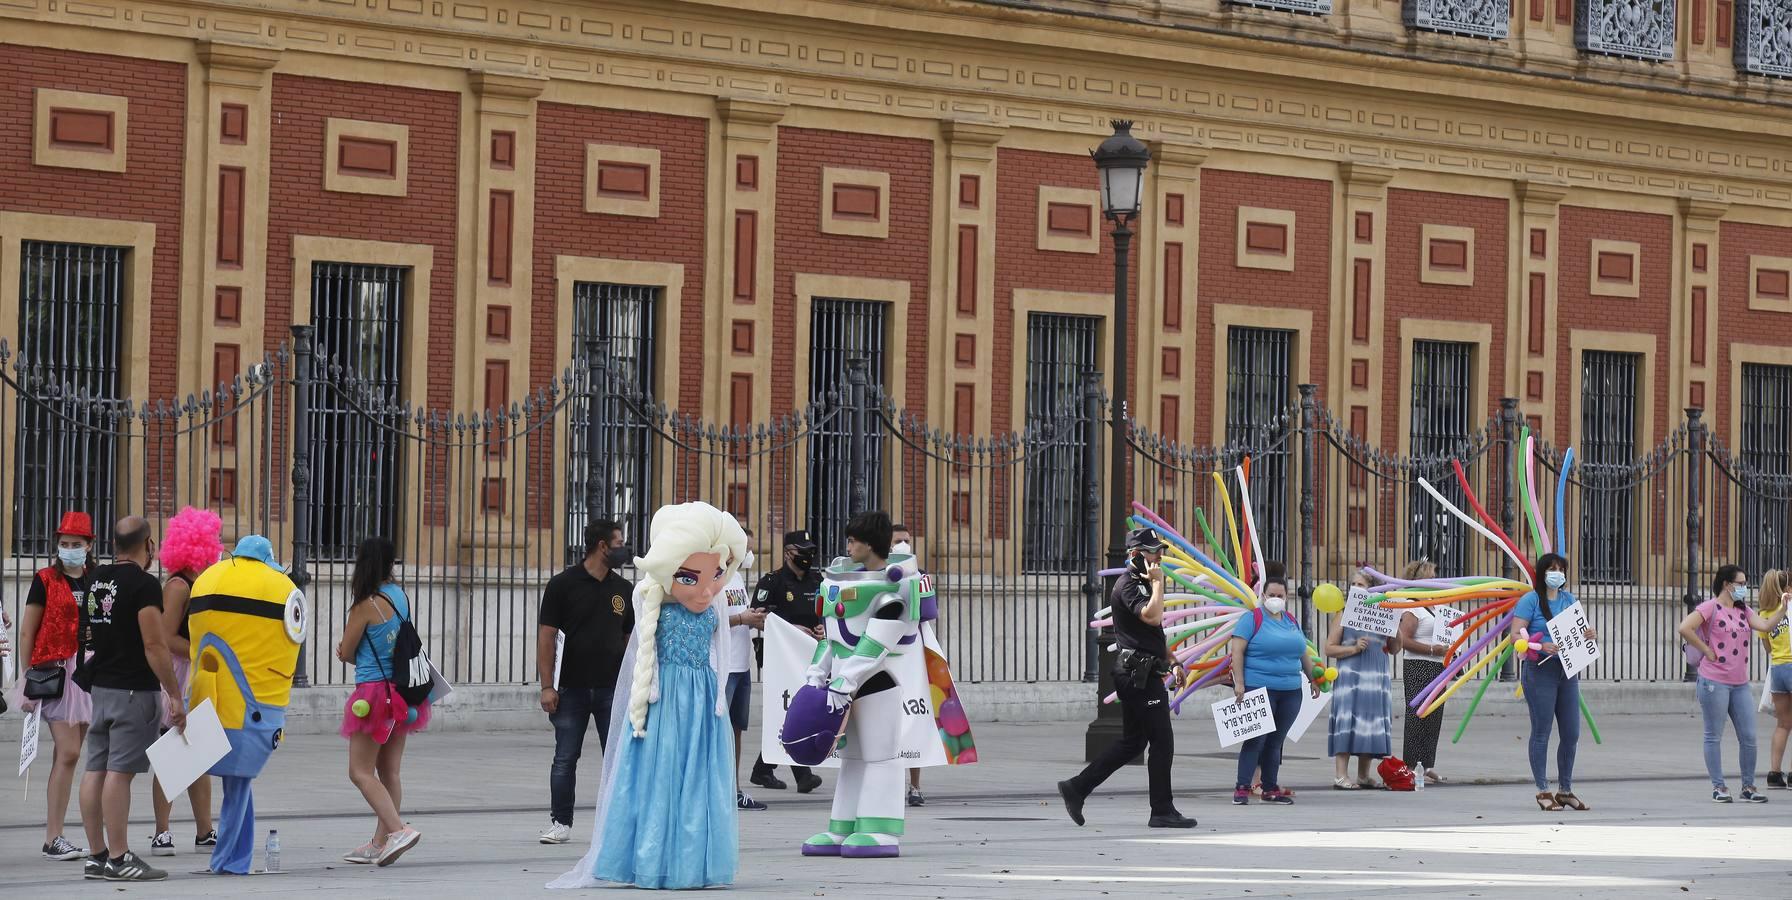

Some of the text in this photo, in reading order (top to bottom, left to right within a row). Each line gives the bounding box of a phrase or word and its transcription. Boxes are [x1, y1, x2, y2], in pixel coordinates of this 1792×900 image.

[1357, 615, 1386, 626] LIMPIOS
[1443, 609, 1451, 618] DE
[1348, 620, 1363, 628] QUE
[1576, 617, 1588, 634] DE
[1565, 635, 1574, 650] SIN
[1570, 626, 1582, 648] DIAS
[1551, 624, 1573, 670] TRABAJAR
[1241, 722, 1261, 736] SIEMPRE
